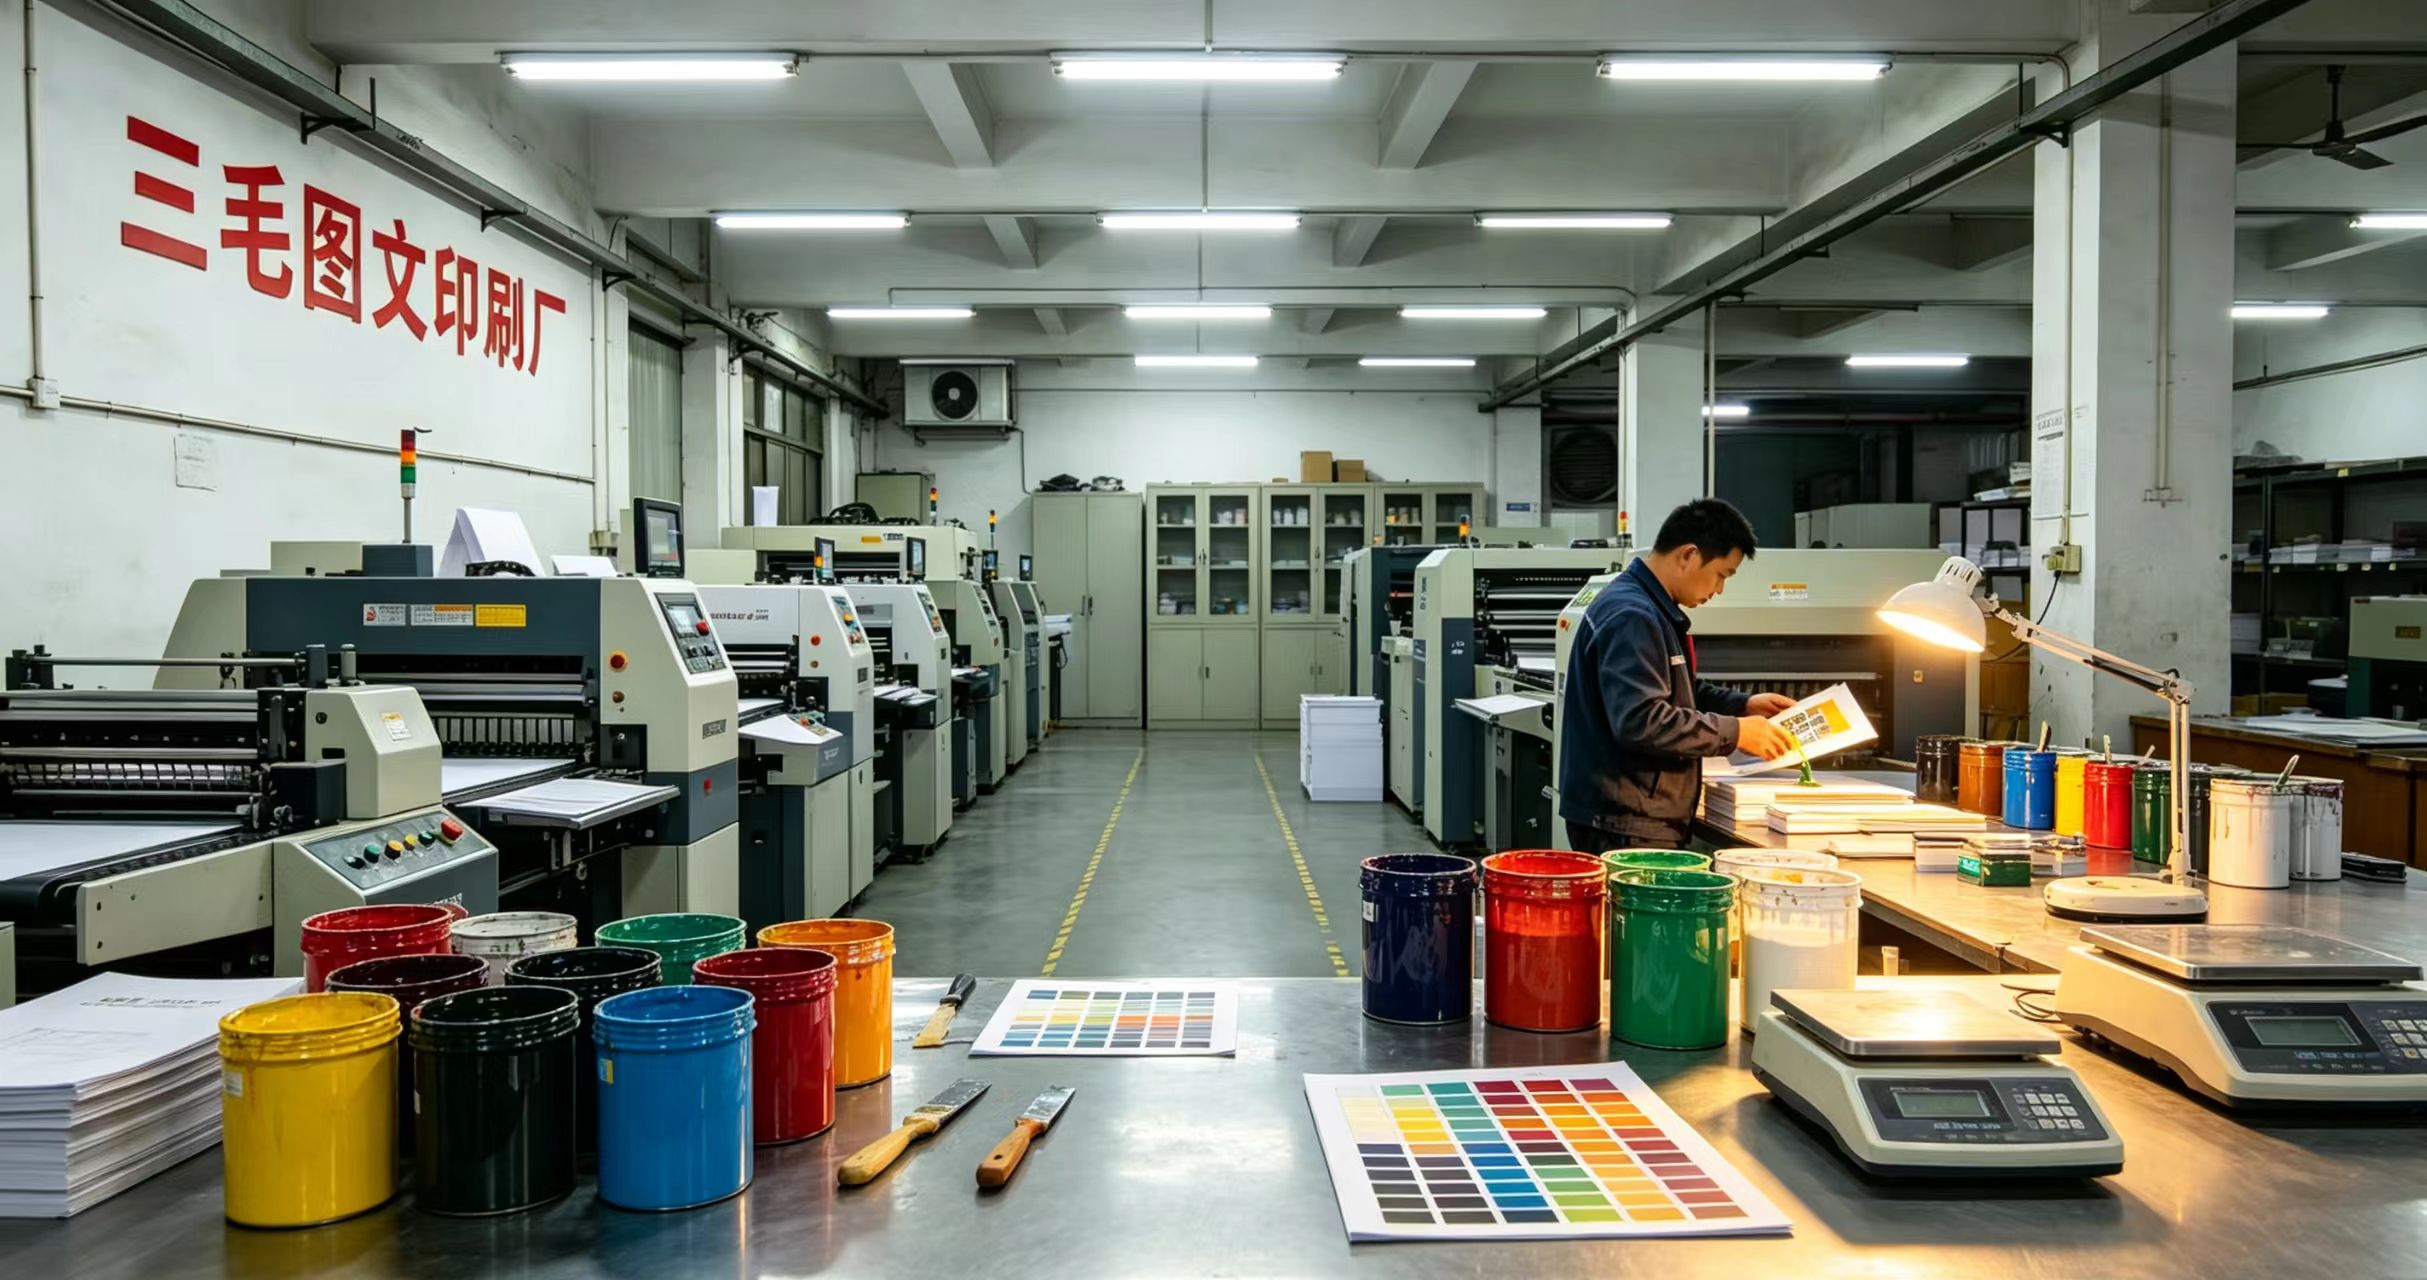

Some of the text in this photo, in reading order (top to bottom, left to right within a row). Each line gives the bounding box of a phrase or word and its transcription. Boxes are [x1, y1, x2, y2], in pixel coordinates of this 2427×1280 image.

[121, 115, 566, 375] 三毛图文印刷厂
